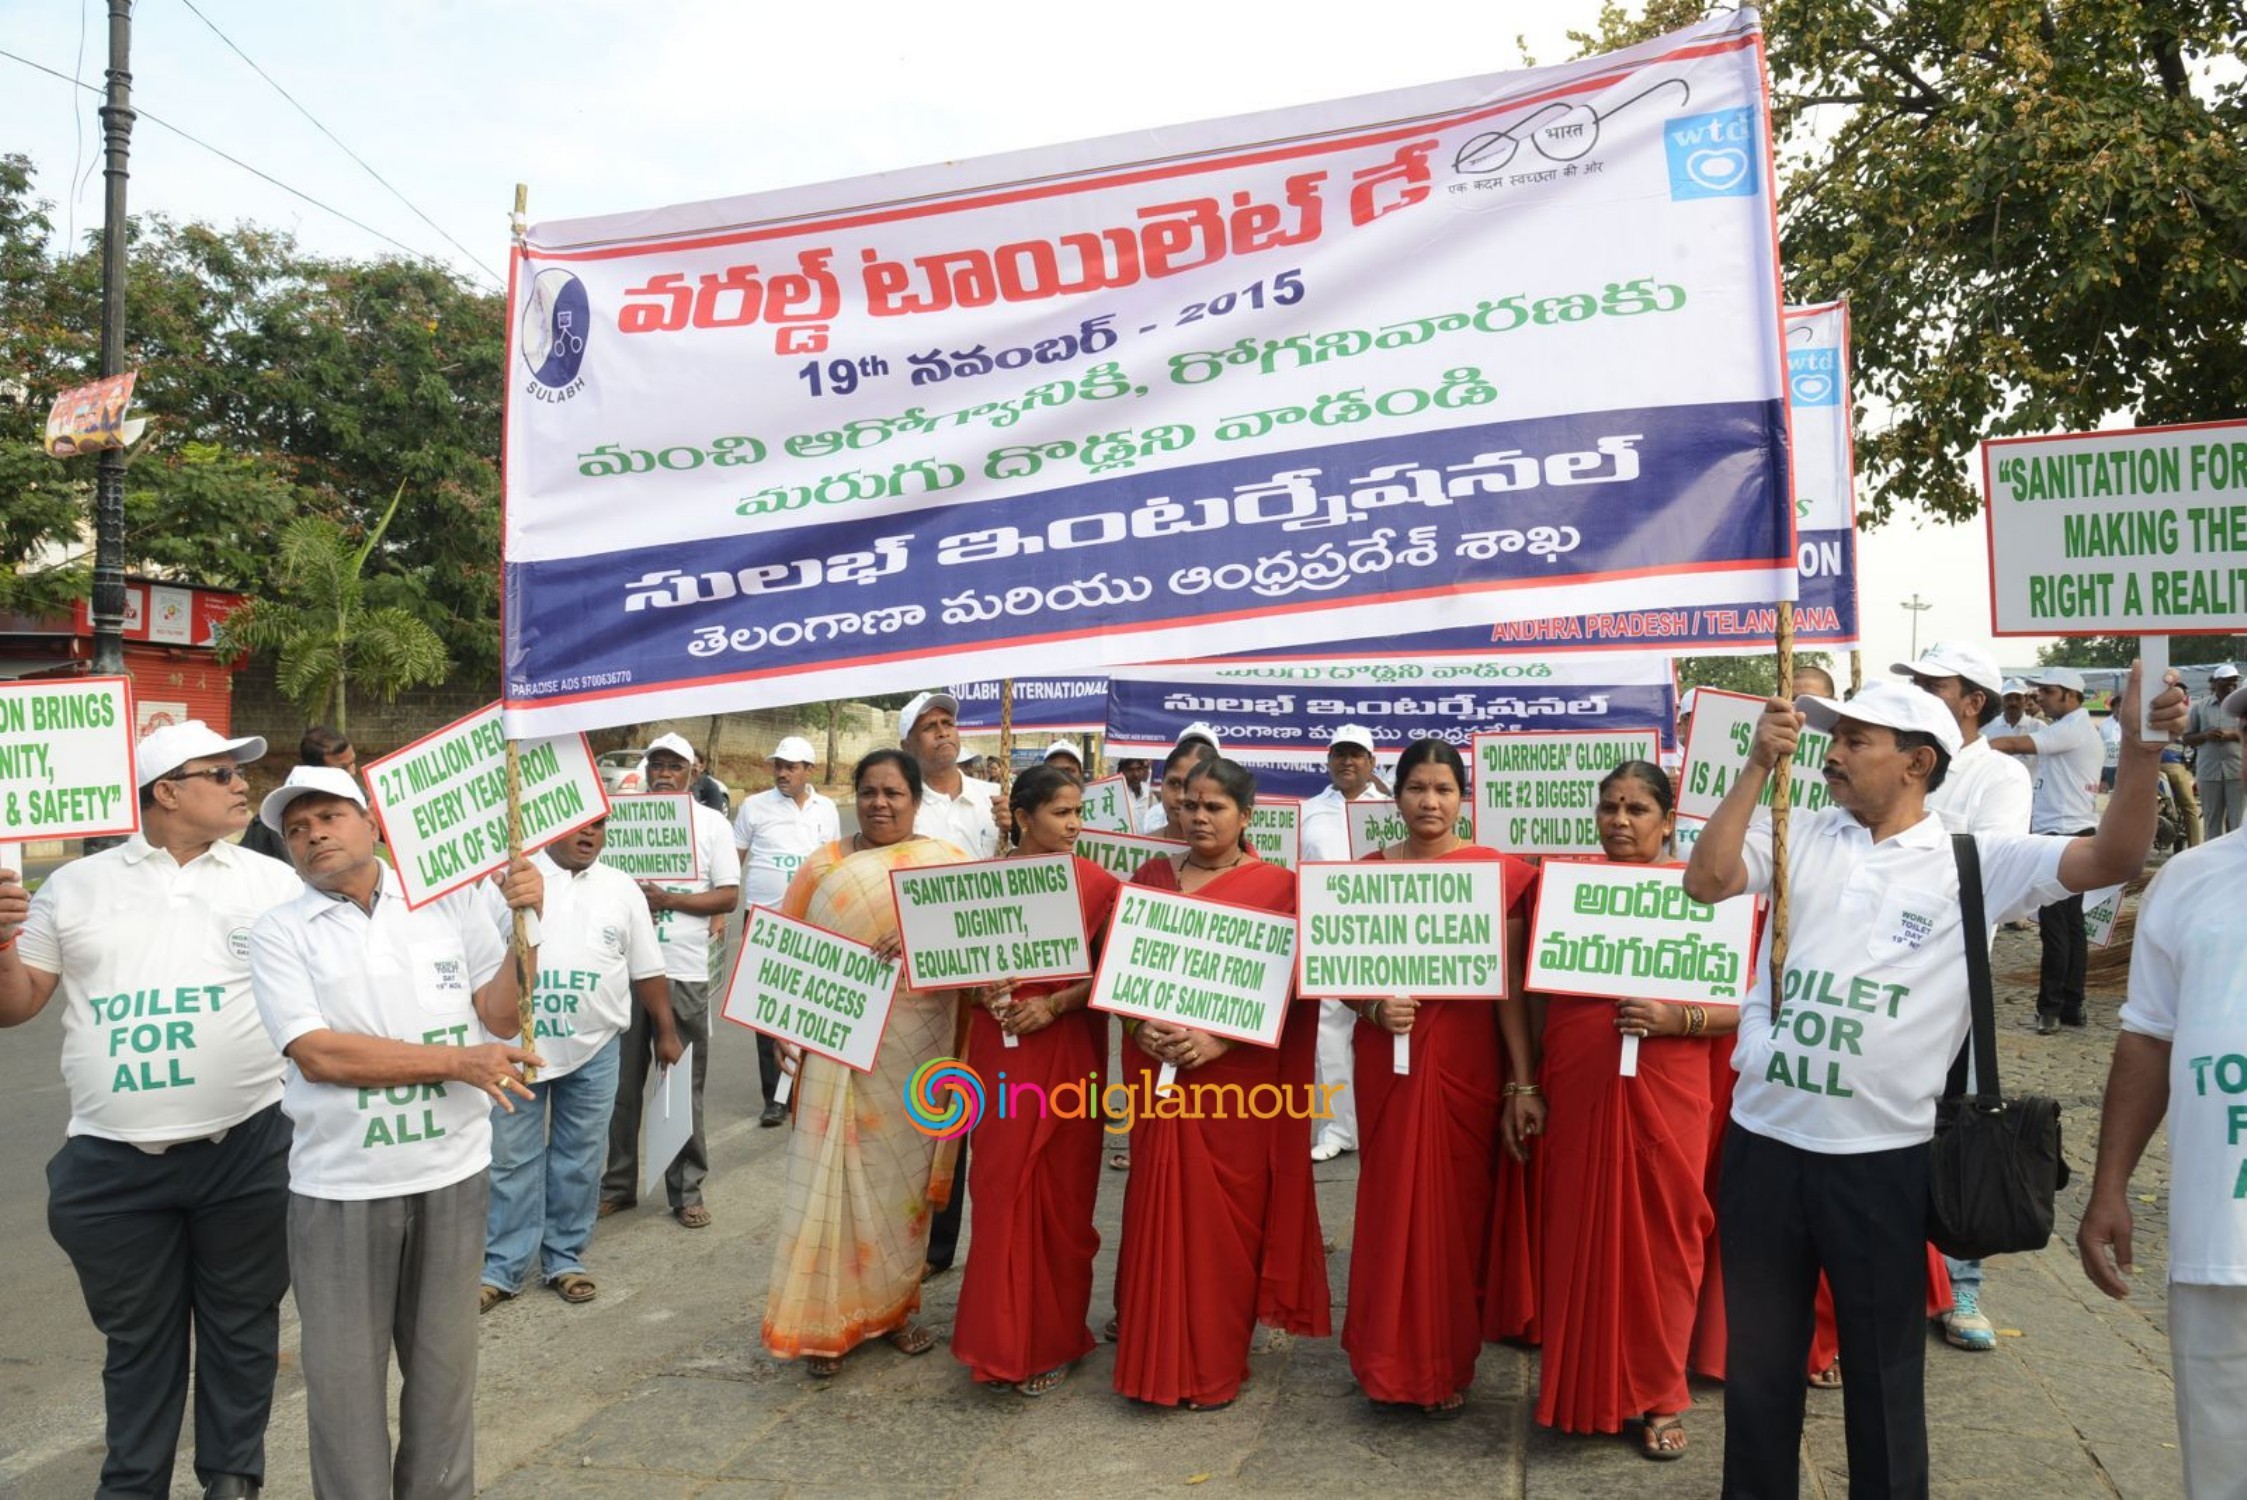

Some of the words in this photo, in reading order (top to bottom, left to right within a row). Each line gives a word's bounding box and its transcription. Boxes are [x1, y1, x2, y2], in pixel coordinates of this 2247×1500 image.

[1545, 123, 1583, 140] भारत
[1671, 112, 1749, 147] wtd
[1350, 138, 1440, 227] డే
[1473, 176, 1503, 192] कदम
[799, 354, 889, 397] 19th
[1174, 268, 1305, 327] 2015
[526, 377, 585, 403] SULABH
[578, 435, 767, 477] మంచి
[735, 458, 965, 516] మరుగు
[1214, 365, 1498, 442] వాడండి
[1998, 446, 2181, 502] “SANITATION
[2190, 441, 2247, 491] FOR
[2064, 508, 2179, 558] MAKING
[2187, 505, 2247, 554] THE
[625, 533, 914, 612] సులభ్
[687, 603, 926, 658] తెలంగాణా
[941, 572, 1152, 626] మరియు
[1168, 524, 1439, 597] ఆంధ్రప్రదేశ్
[1454, 524, 1581, 564] శాఖ
[2029, 572, 2114, 619] RIGHT
[2123, 572, 2144, 616] A
[2151, 569, 2247, 616] REALIT
[1491, 614, 1582, 643] ANDHRA
[1585, 611, 1689, 639] PRADESH
[1702, 606, 1841, 635] TELANANA
[511, 680, 559, 696] PARADISE
[561, 678, 580, 691] ADS
[949, 682, 999, 701] SULABH
[1011, 680, 1109, 700] NTERNATIONAL
[31, 691, 115, 732] BRINGS
[379, 767, 407, 808] 2.7
[404, 734, 474, 795] MILLION
[469, 716, 506, 762] PEO
[1482, 743, 1573, 772] “DIARRHOEA”
[1485, 781, 1513, 809] THE
[1516, 780, 1532, 809] #2
[1535, 780, 1595, 809] BIGGEST
[1689, 760, 1710, 795] IS
[1712, 765, 1727, 798] A
[6, 791, 22, 826] &
[28, 784, 121, 825] SAFETY”
[412, 786, 467, 841] EVERY
[607, 801, 676, 822] ANITATION
[1278, 810, 1294, 828] DIE
[604, 828, 644, 848] STAIN
[646, 827, 687, 847] CLEAN
[1255, 833, 1281, 852] FROM
[1510, 817, 1527, 846] OF
[1531, 817, 1572, 846] CHILD
[1576, 817, 1601, 846] DEA
[417, 838, 466, 887] LACK
[462, 826, 488, 865] OF
[902, 870, 1004, 906] “SANITATION
[1006, 863, 1068, 897] BRINGS
[1326, 872, 1473, 905] “SANITATION
[1121, 895, 1147, 929] 2.7
[1145, 900, 1208, 939] MILLION
[1207, 912, 1267, 951] PEOPLE
[1265, 924, 1295, 957] DIE
[1310, 914, 1408, 946] SUSTAIN
[1415, 913, 1491, 945] CLEAN
[1901, 919, 1932, 935] TOILET
[1905, 930, 1923, 942] DAY
[751, 917, 779, 949] 2.5
[777, 927, 844, 973] BILLION
[842, 950, 895, 991] DON'T
[914, 944, 990, 980] EQUALITY
[997, 944, 1009, 972] &
[1012, 937, 1079, 970] SAFETY”
[1130, 936, 1181, 973] EVERY
[1181, 946, 1223, 982] YEAR
[1221, 955, 1267, 992] FROM
[1305, 954, 1498, 987] ENVIRONMENTS”
[89, 985, 226, 1026] TOILET
[531, 993, 579, 1014] FOR
[757, 957, 803, 996] HAVE
[801, 975, 868, 1020] ACCESS
[1111, 972, 1154, 1008] LACK
[1153, 981, 1177, 1011] OF
[1175, 985, 1267, 1032] SANITATION
[1784, 968, 1911, 1019] OILET
[109, 1020, 197, 1057] FOR
[756, 993, 778, 1024] TO
[777, 1003, 792, 1031] A
[795, 1007, 852, 1052] TOILET
[1771, 1008, 1863, 1057] FOR
[112, 1058, 196, 1093] ALL
[1765, 1051, 1853, 1098] ALL
[363, 1109, 446, 1149] ALL
